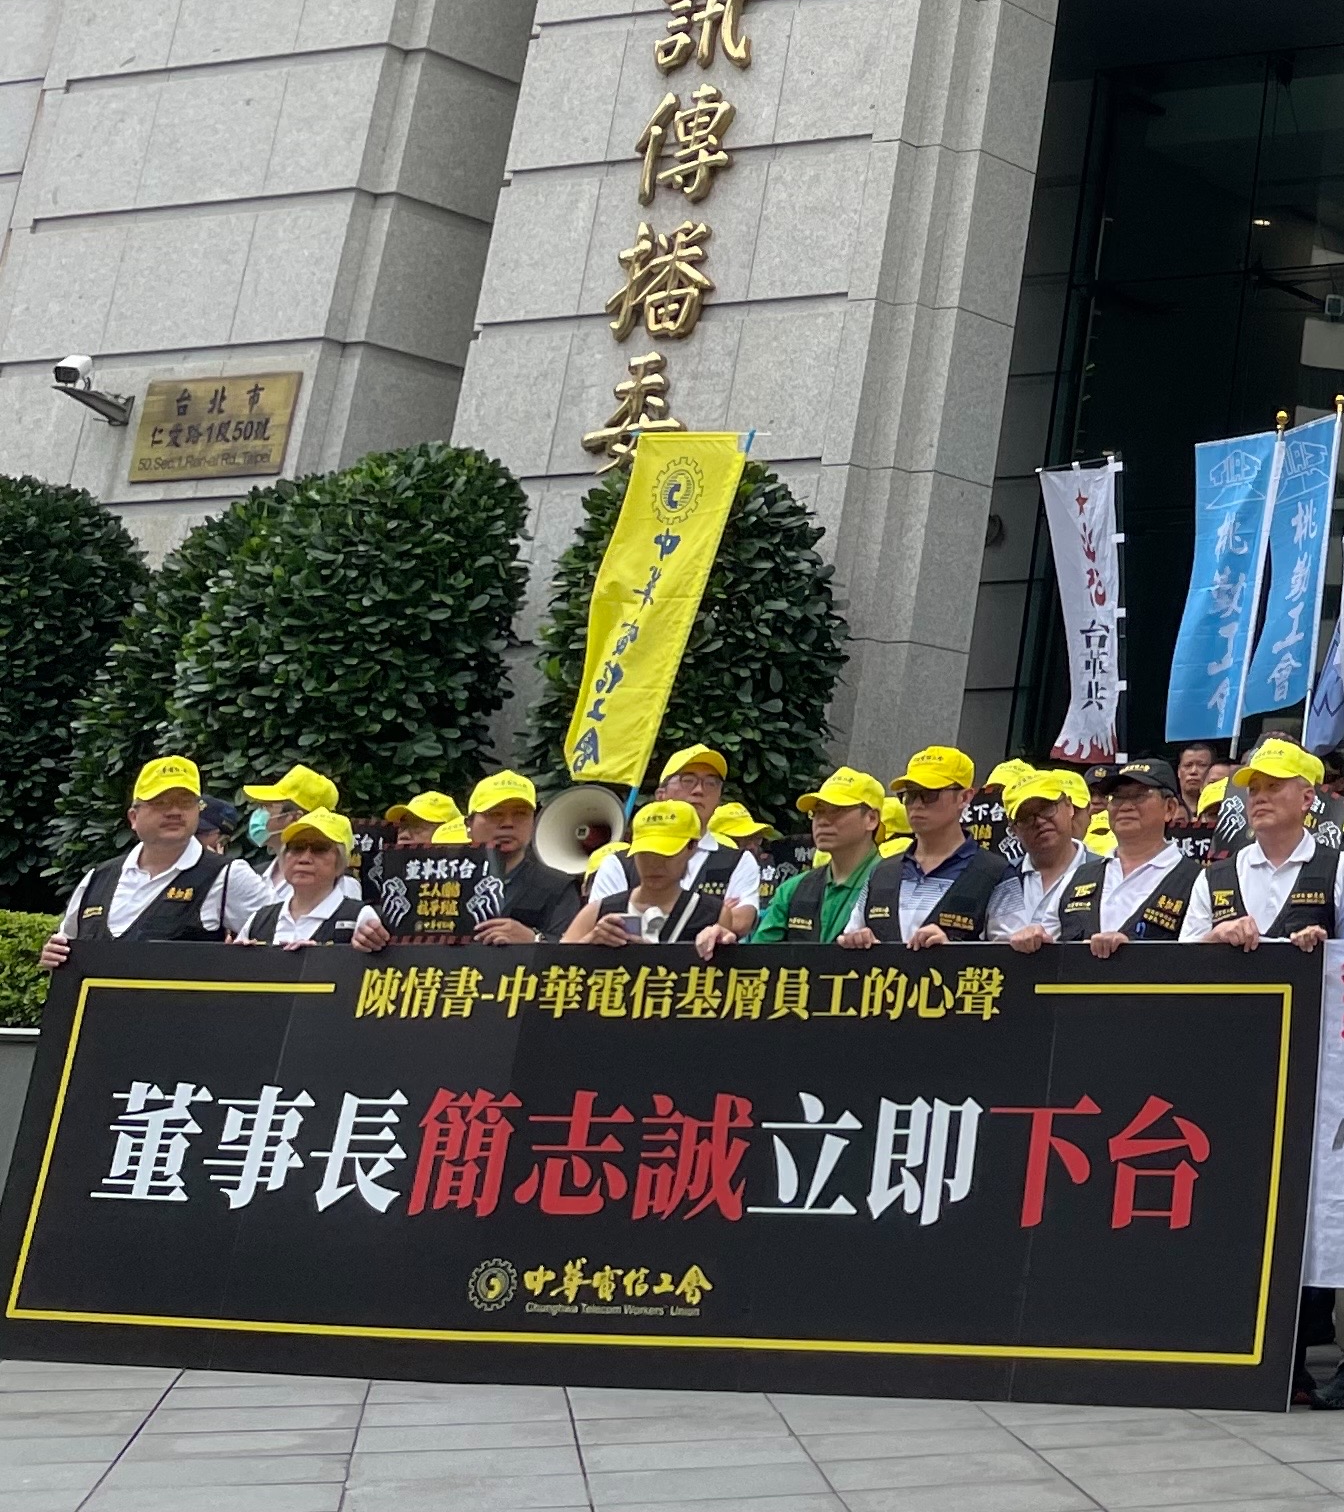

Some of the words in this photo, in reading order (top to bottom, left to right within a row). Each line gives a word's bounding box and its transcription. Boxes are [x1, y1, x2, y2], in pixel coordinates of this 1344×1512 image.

[176, 384, 265, 417] 台北市
[1265, 498, 1318, 703] 桃勤工會
[404, 858, 490, 881] 董事長下台！
[354, 963, 1004, 1022] 陳情書-中華電信基層員工的心聲
[89, 1079, 1212, 1230] 董事長簡志誠立即下台
[523, 1257, 714, 1305] 中華電信工會
